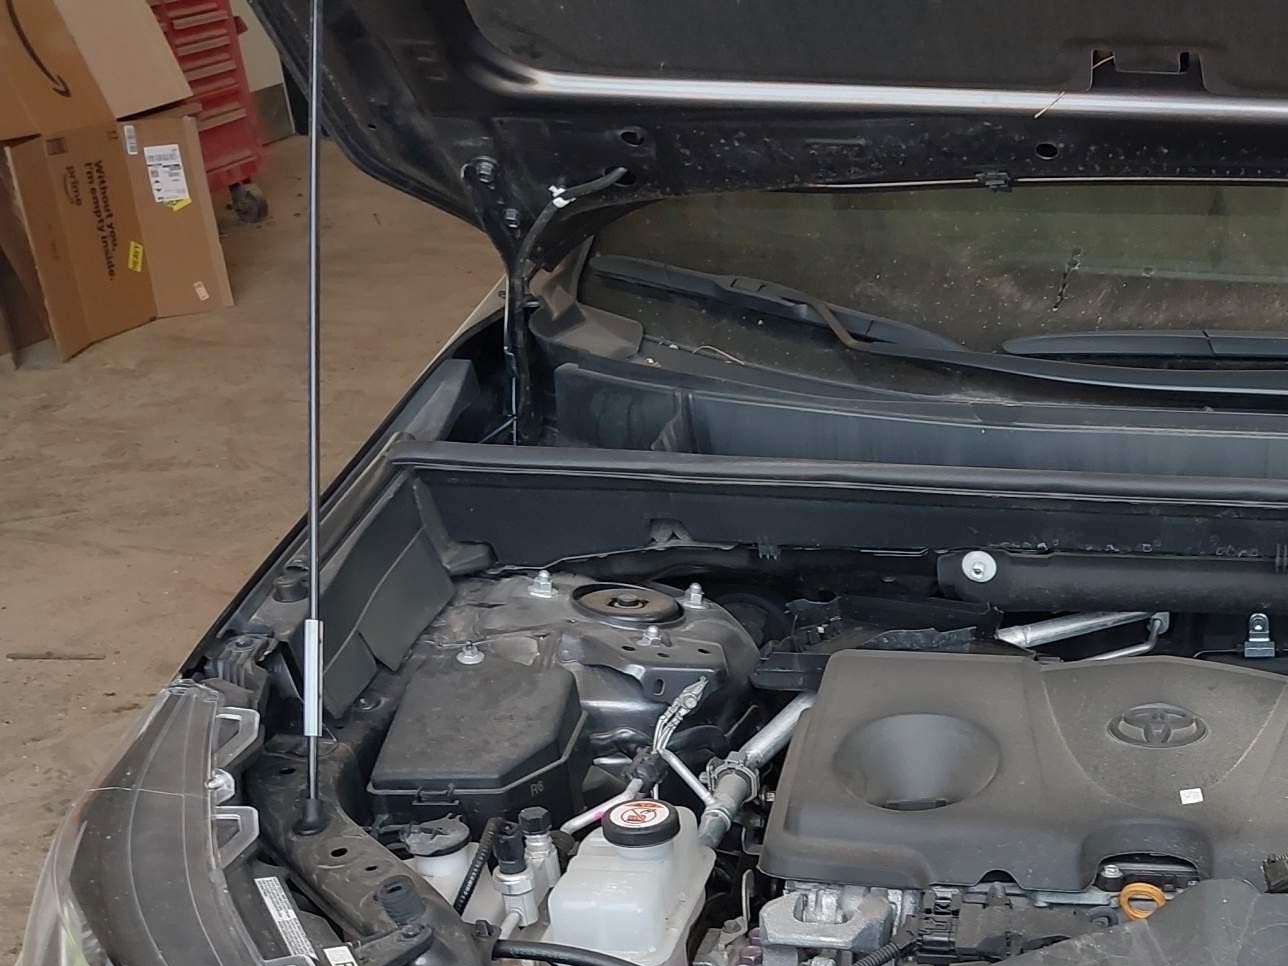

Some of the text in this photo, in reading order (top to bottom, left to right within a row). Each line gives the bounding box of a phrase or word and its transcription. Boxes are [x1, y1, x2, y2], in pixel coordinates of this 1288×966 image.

[66, 165, 83, 207] prime
[94, 160, 114, 219] Without
[84, 162, 116, 281] I'm empty inside.
